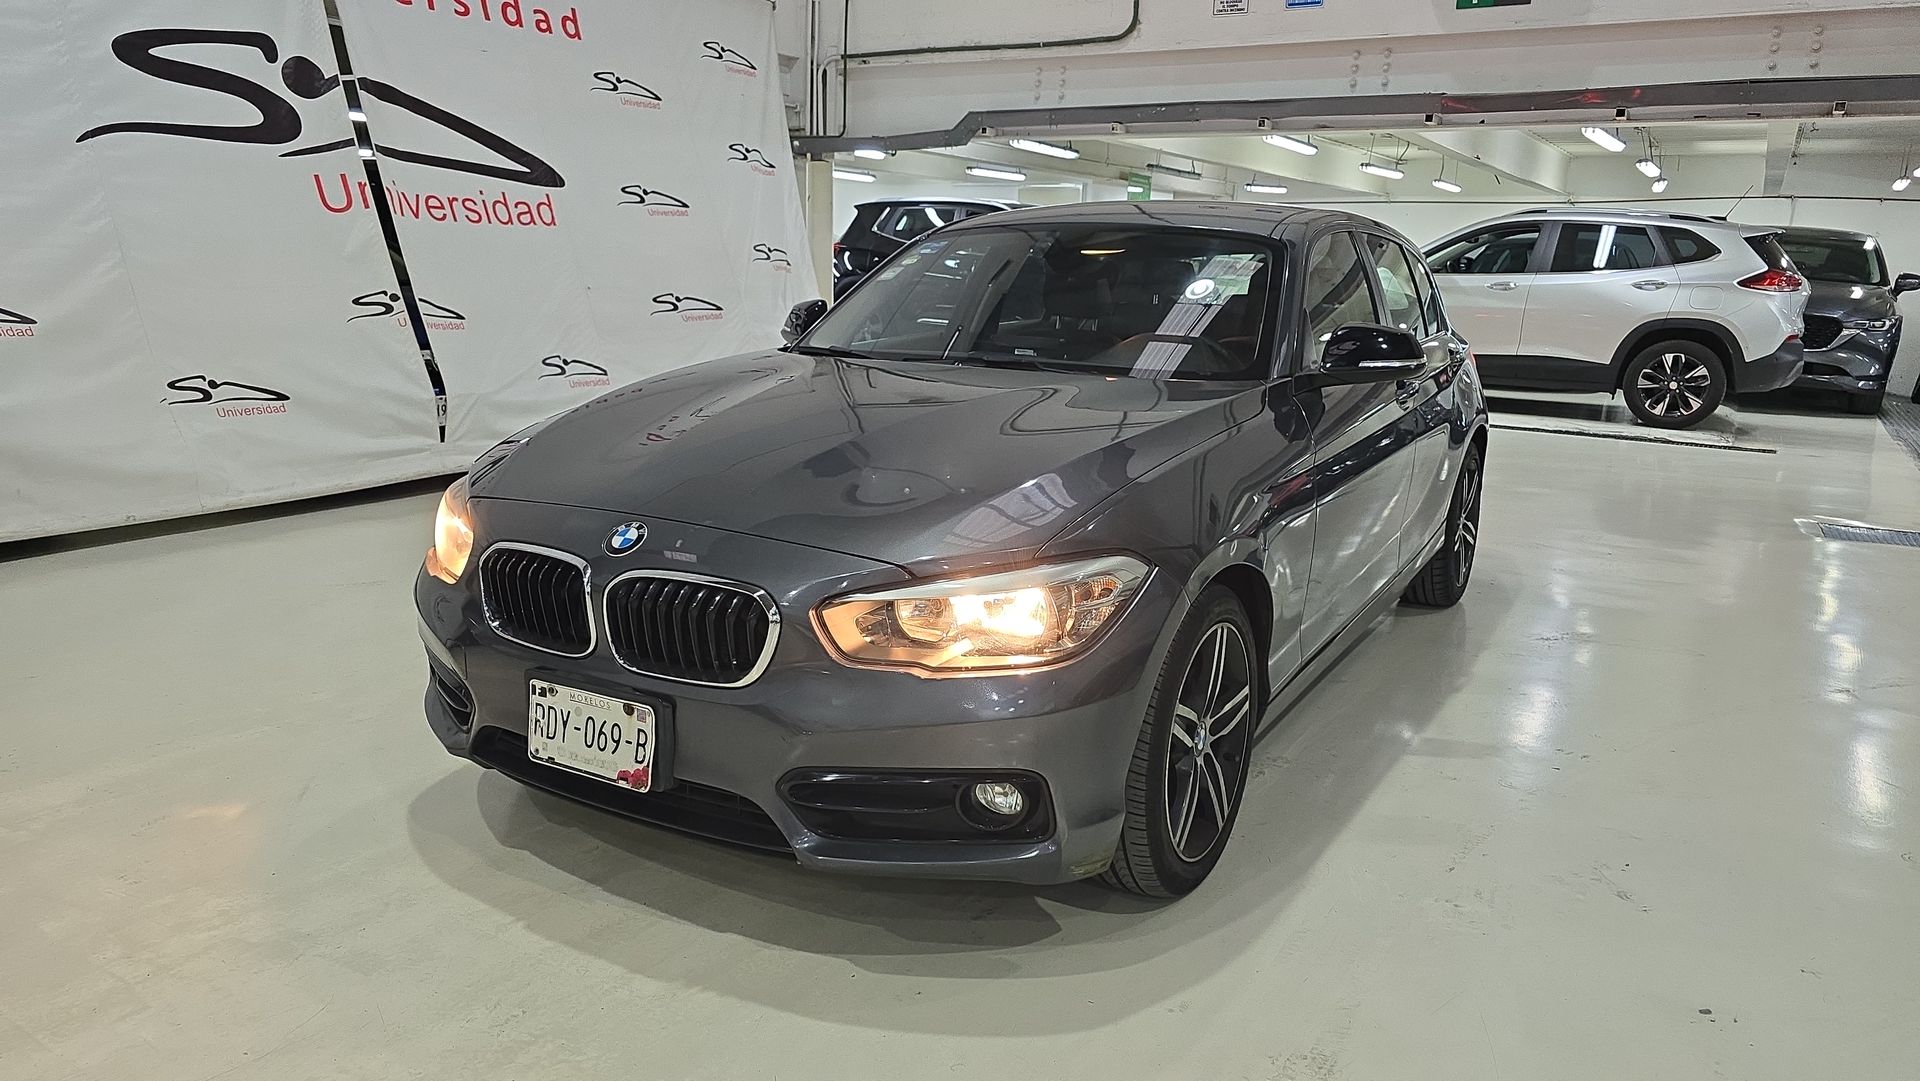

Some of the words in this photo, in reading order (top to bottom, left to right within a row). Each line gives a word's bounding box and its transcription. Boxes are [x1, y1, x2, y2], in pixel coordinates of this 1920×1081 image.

[397, 314, 466, 330] Uiversidad
[0, 325, 35, 338] idad
[216, 402, 287, 418] Universidad
[569, 692, 611, 709] MORELOS
[534, 702, 648, 765] RDY-069-B
